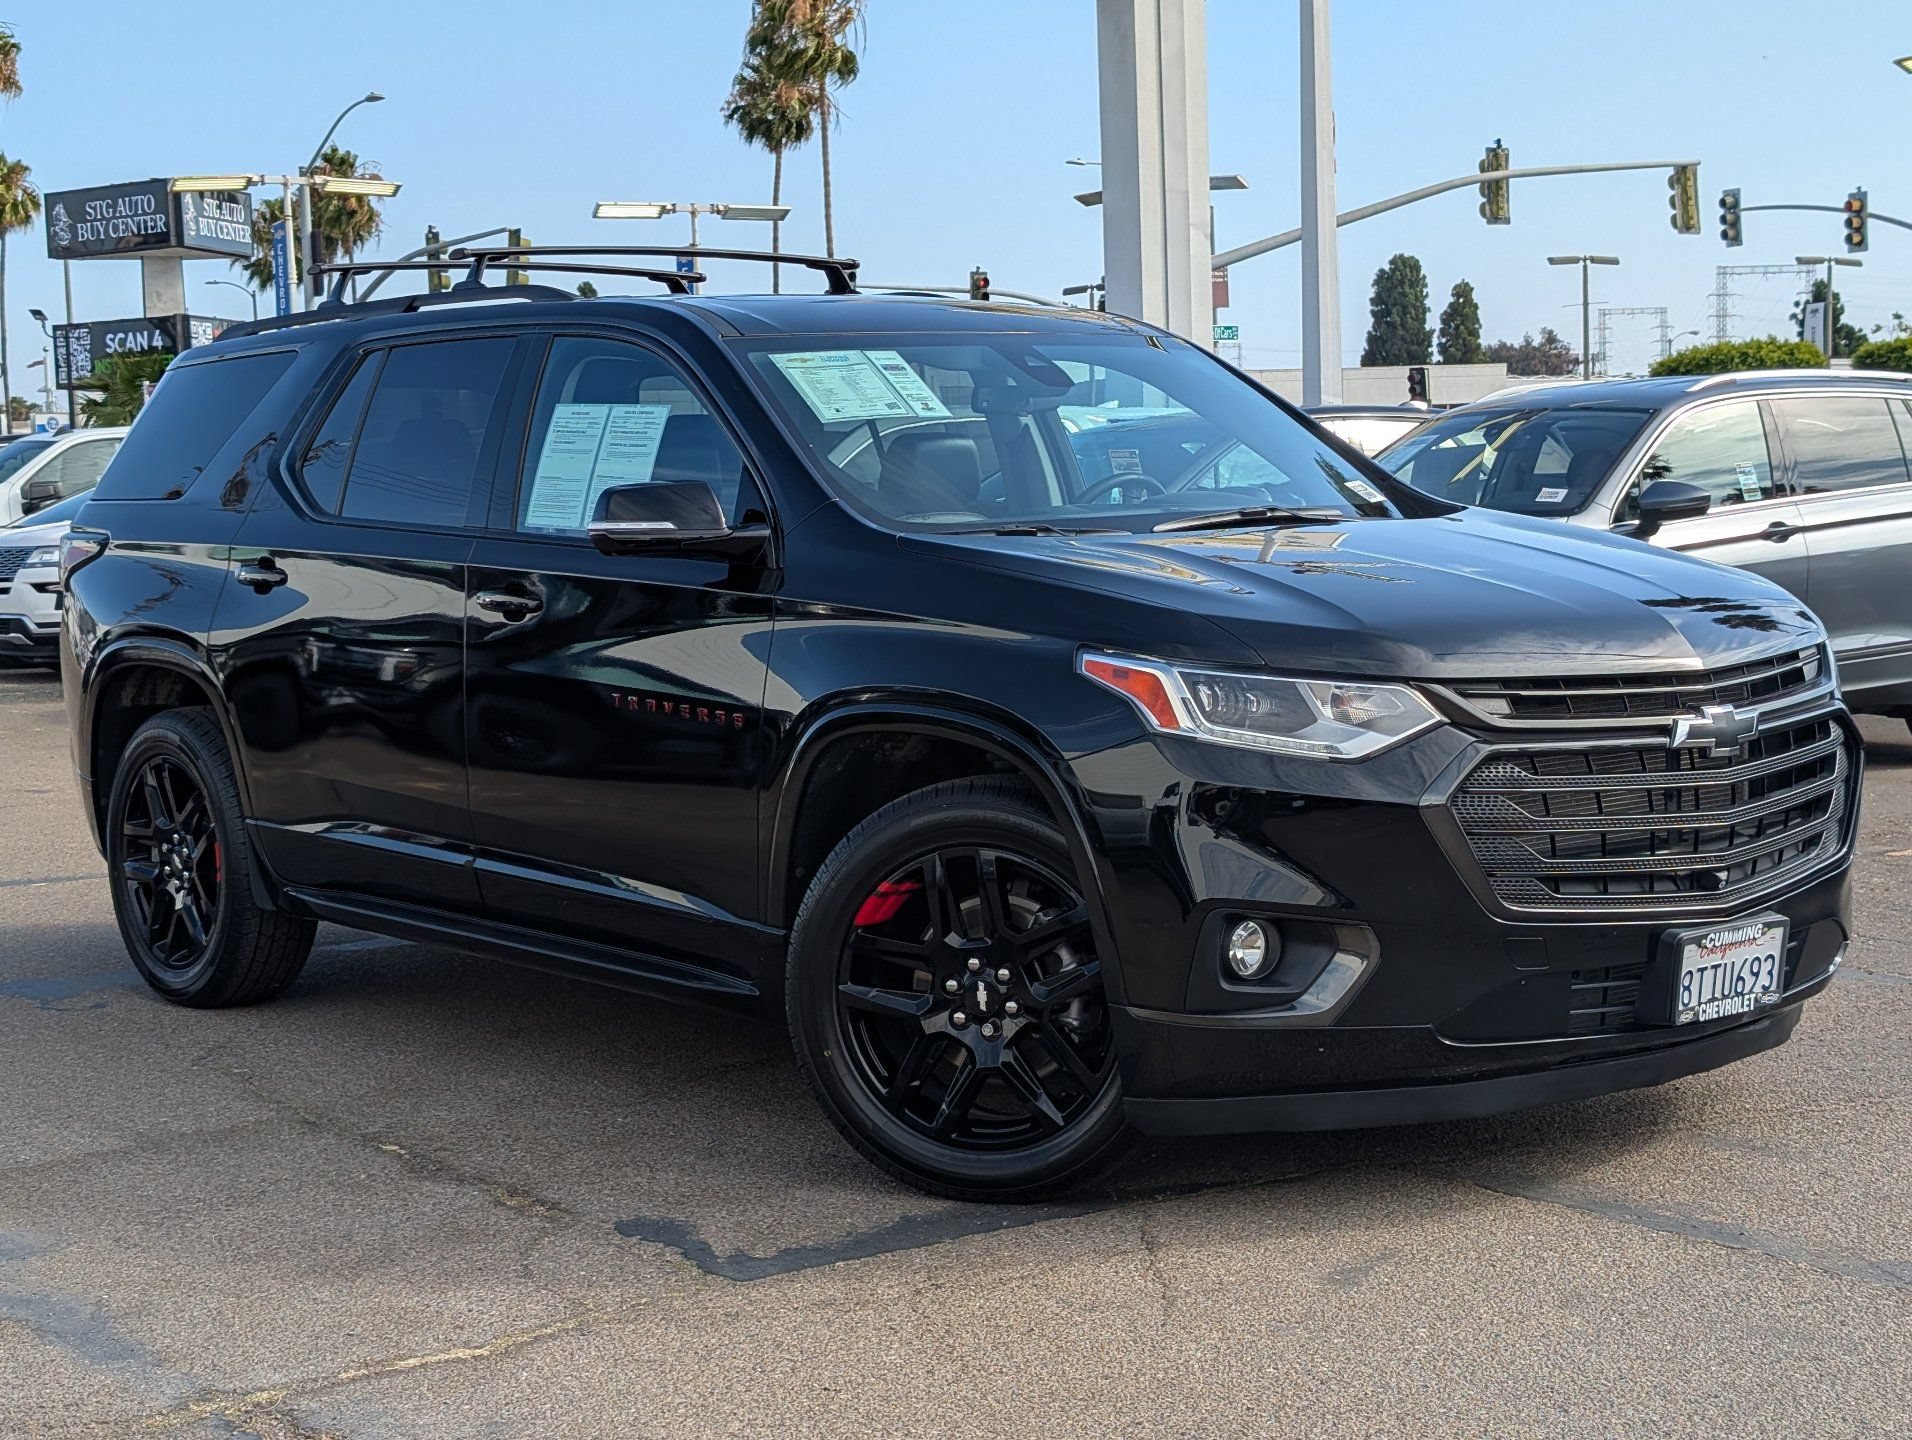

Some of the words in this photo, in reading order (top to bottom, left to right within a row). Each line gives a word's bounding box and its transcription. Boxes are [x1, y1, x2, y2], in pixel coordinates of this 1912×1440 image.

[85, 200, 113, 220] STG
[116, 195, 155, 216] AUTO
[203, 199, 219, 218] STG
[221, 203, 245, 223] AUTO
[77, 222, 107, 242] BUY
[109, 214, 168, 238] CENTER
[200, 217, 217, 238] BUY
[217, 221, 252, 243] CENTER
[105, 331, 151, 353] SCAN
[152, 329, 163, 350] 4
[1221, 326, 1233, 339] Cars
[611, 693, 744, 730] TRAVERSE
[1706, 924, 1763, 948] CUMMING
[1699, 993, 1755, 1022] CHEVROLET
